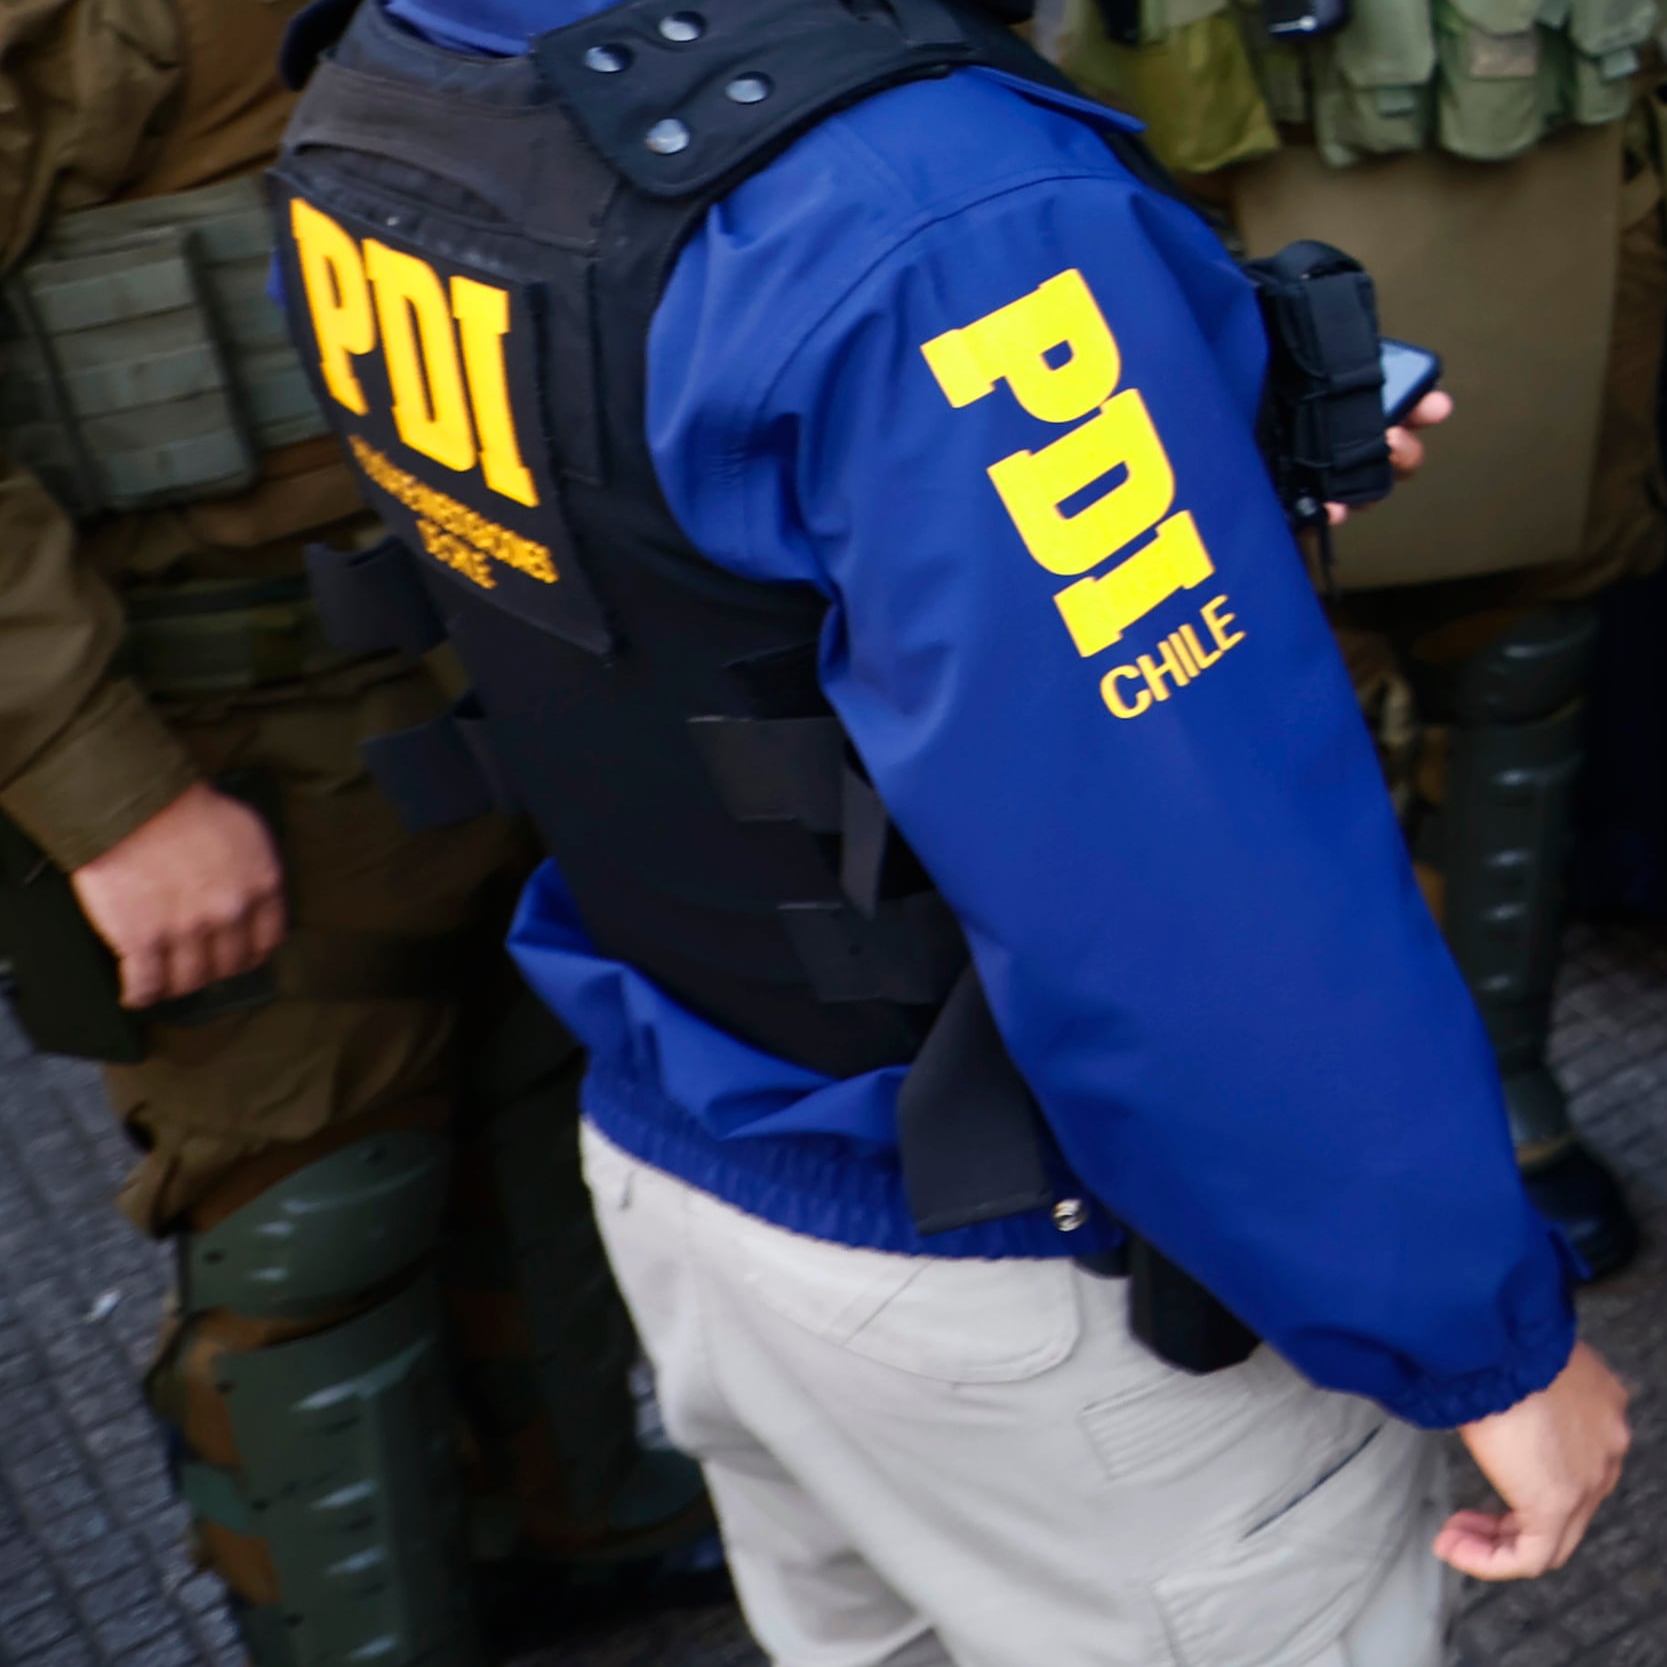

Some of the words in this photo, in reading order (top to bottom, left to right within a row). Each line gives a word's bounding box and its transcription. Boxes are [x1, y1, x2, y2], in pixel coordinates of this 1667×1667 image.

[289, 197, 539, 508] PDI
[921, 268, 1215, 658] PDI
[1100, 595, 1246, 720] CHILE
